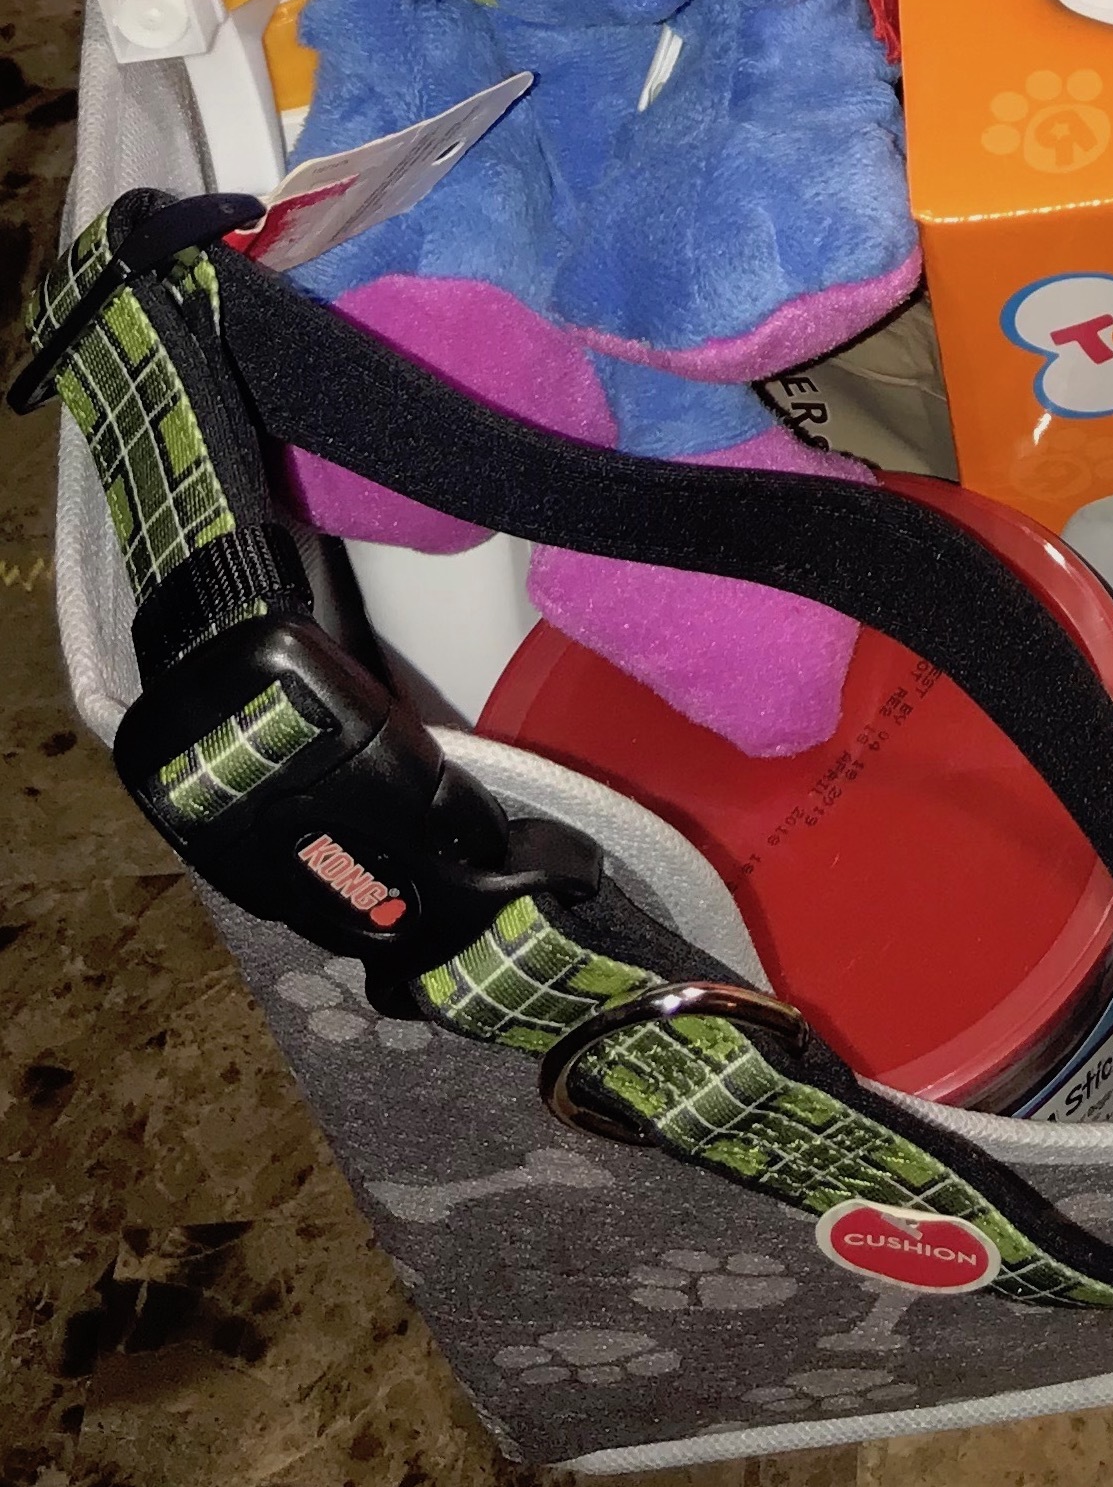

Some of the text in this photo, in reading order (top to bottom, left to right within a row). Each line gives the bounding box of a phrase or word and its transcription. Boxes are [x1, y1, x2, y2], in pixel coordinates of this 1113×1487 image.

[910, 660, 929, 683] OT
[914, 664, 944, 699] EST
[297, 833, 389, 911] KONG
[843, 1232, 978, 1267] CUSHION
